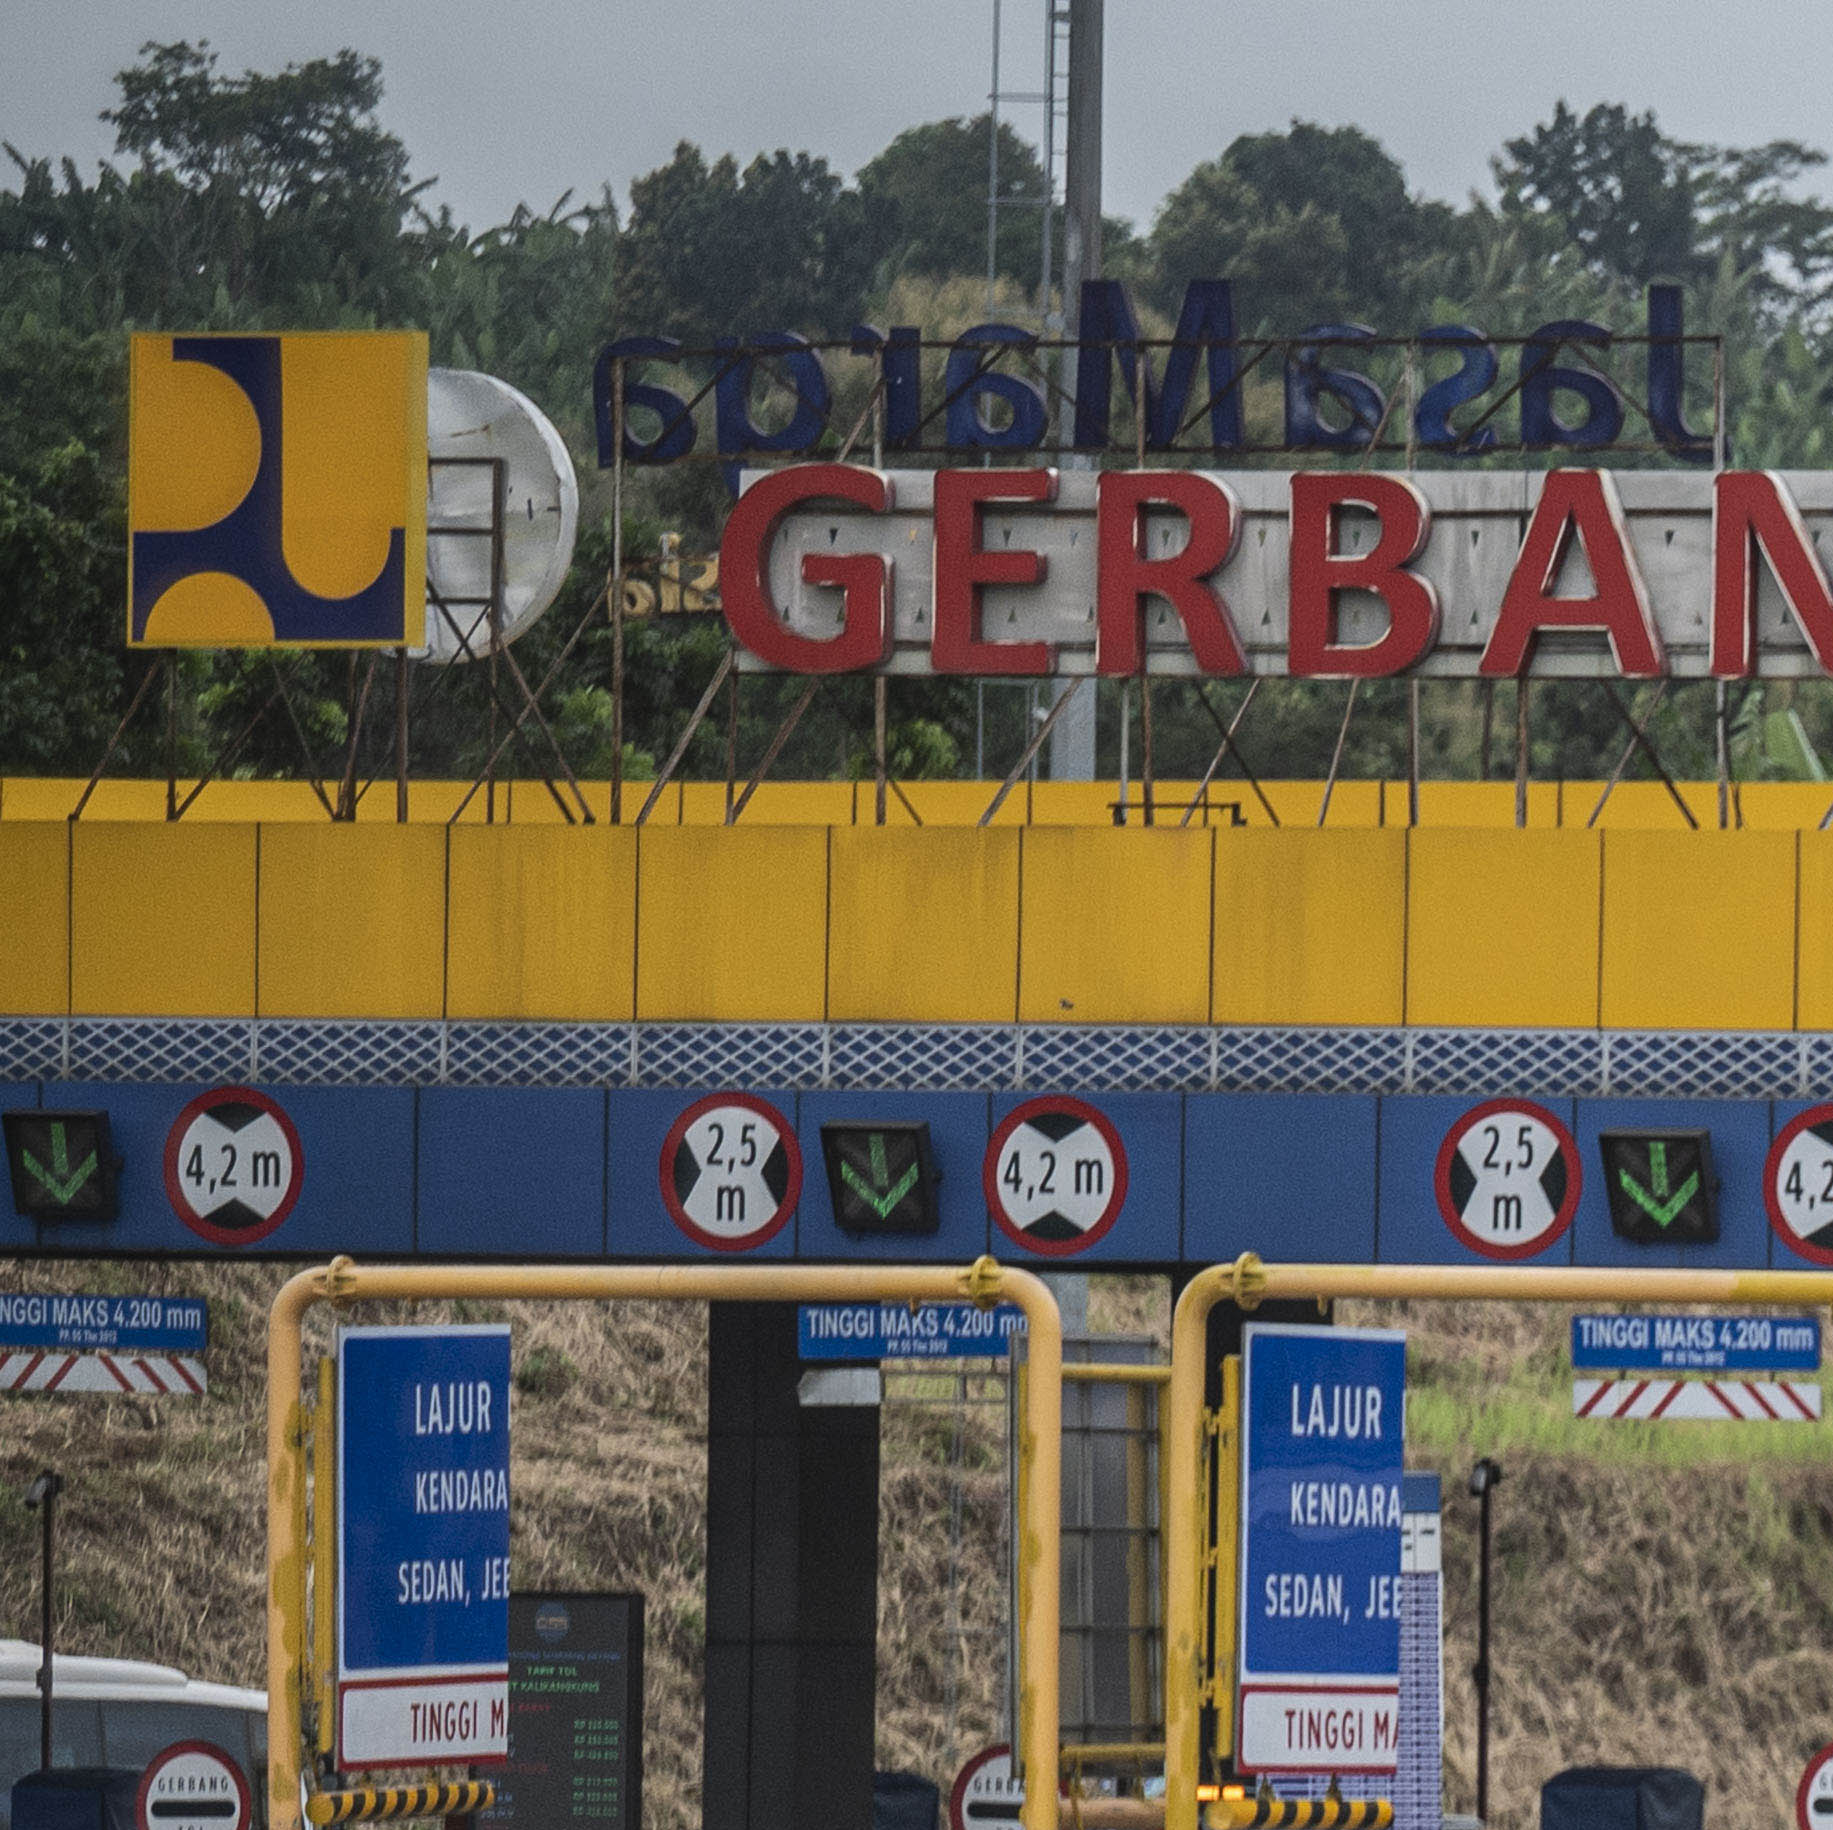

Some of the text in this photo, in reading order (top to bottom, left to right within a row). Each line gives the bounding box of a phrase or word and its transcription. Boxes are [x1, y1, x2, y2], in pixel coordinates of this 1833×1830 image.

[186, 1143, 282, 1195] 4,2 m
[706, 1123, 759, 1176] 2,5
[1482, 1124, 1535, 1178] 2,5
[1003, 1150, 1106, 1203] 4,2 m
[715, 1182, 746, 1222] m
[1492, 1191, 1523, 1231] m
[52, 1297, 109, 1328] MAKS
[113, 1299, 162, 1329] 4.200
[166, 1305, 201, 1330] mm
[806, 1307, 875, 1339] TINGGI
[879, 1308, 939, 1339] MAKS
[942, 1309, 994, 1339] 4.200
[1579, 1317, 1814, 1352] TINGGI MAKS 4.200 mm
[414, 1383, 491, 1436] LAJUR
[1291, 1384, 1382, 1440] LAJUR
[398, 1560, 471, 1608] SEDAN,
[1265, 1574, 1351, 1627] SEDAN,
[410, 1702, 478, 1744] TINGGI
[1286, 1707, 1364, 1751] TINGGI
[157, 1775, 230, 1793] GERBANG
[973, 1775, 1025, 1795] GERBA
